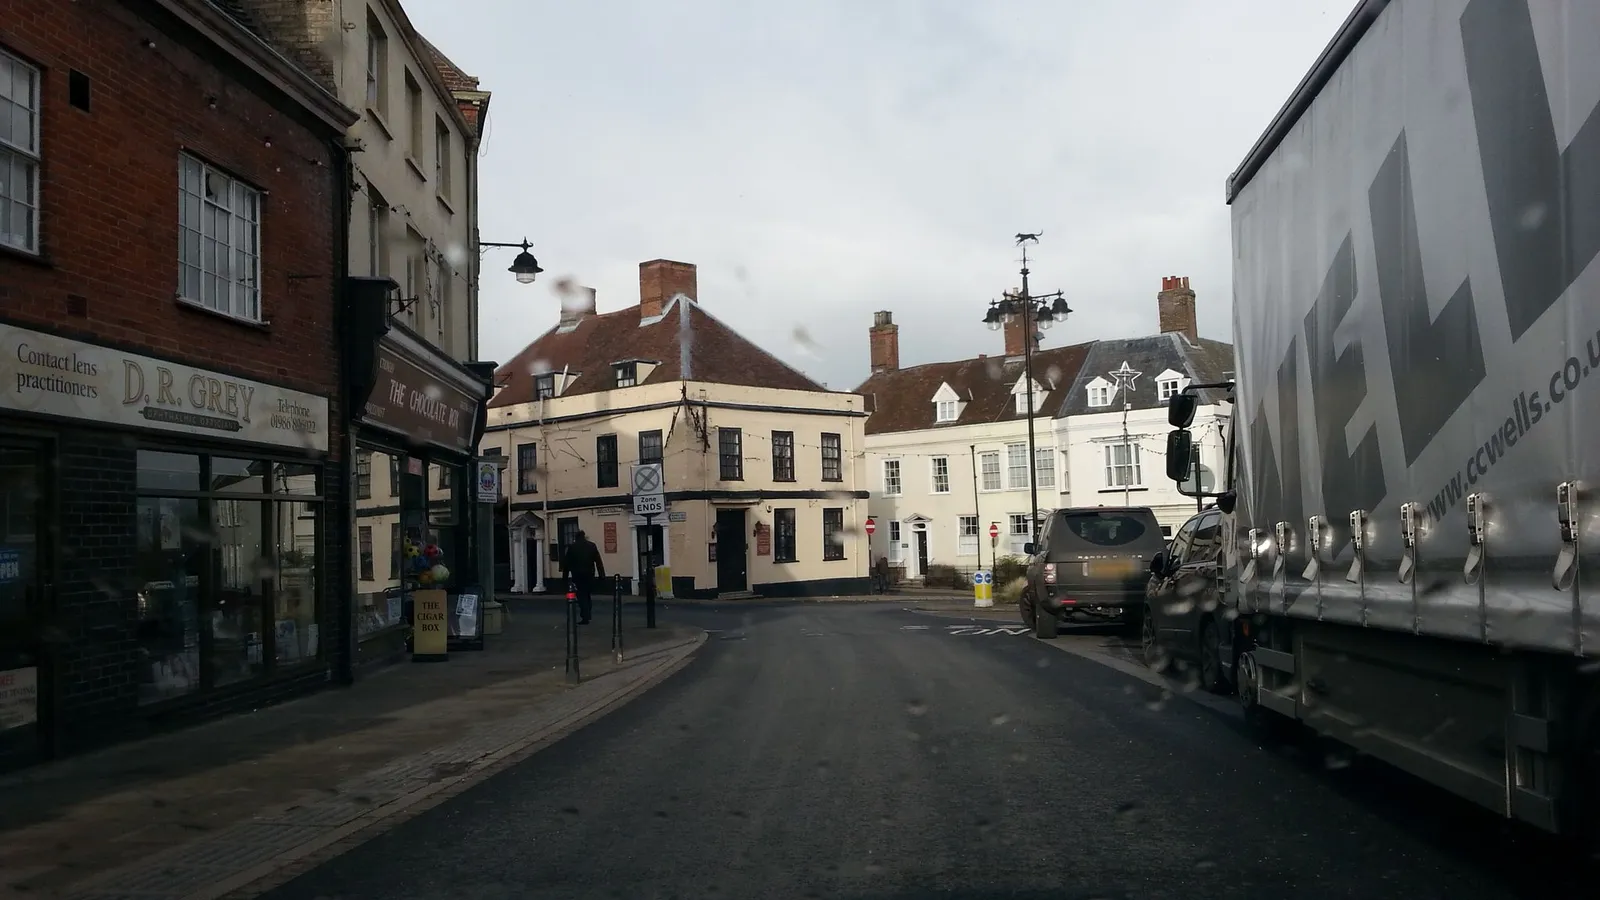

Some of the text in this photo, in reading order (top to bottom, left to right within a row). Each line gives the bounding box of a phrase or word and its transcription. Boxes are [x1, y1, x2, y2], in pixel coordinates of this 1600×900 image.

[17, 343, 97, 376] Contact lens
[16, 372, 98, 399] practitioners
[122, 360, 255, 423] D. R. GREY
[389, 378, 407, 408] THE
[409, 390, 447, 424] CHOCOLATE
[637, 502, 662, 512] ENDS
[422, 601, 441, 610] THE
[416, 612, 445, 621] CIGAR
[422, 623, 440, 632] BOX
